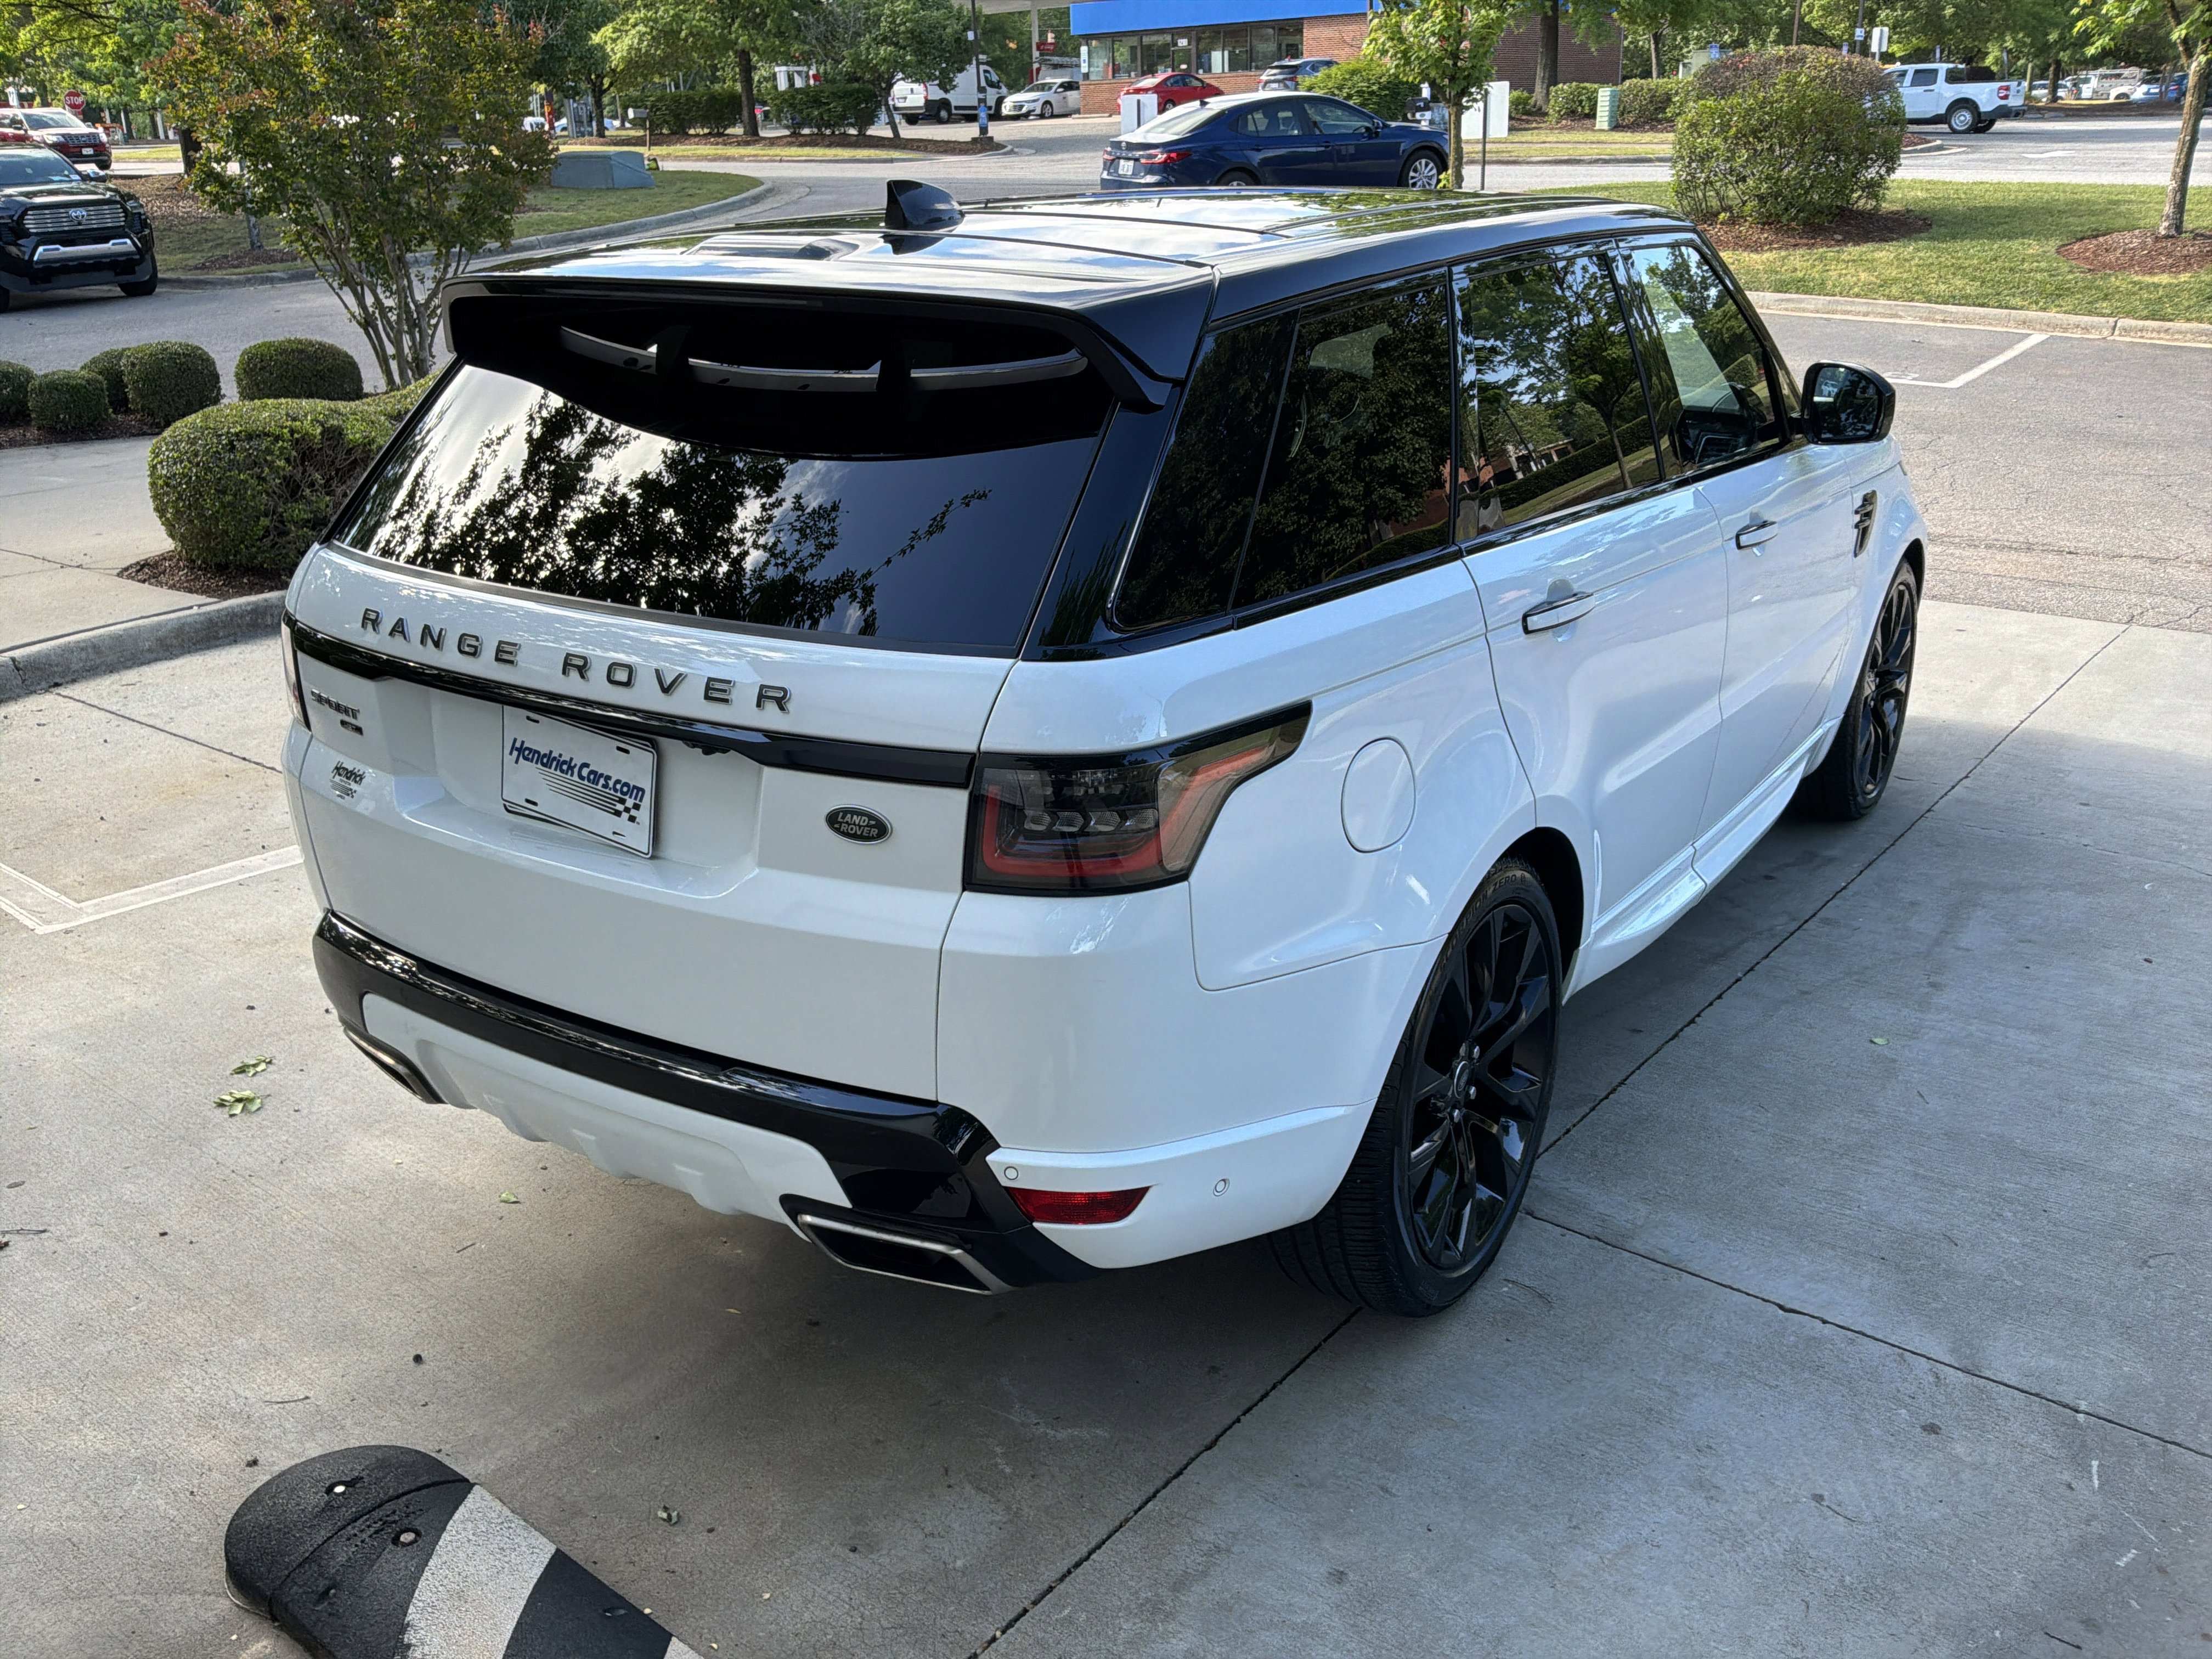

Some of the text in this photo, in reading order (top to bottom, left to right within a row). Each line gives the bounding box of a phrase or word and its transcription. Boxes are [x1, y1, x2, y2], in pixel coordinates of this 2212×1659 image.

[66, 96, 83, 105] STOP
[362, 607, 791, 713] RANGE ROVER
[311, 689, 360, 720] SPORT
[331, 760, 366, 786] Hendrick
[837, 812, 868, 826] LAND
[840, 823, 878, 837] ROVER
[1493, 874, 1516, 892] ZERO
